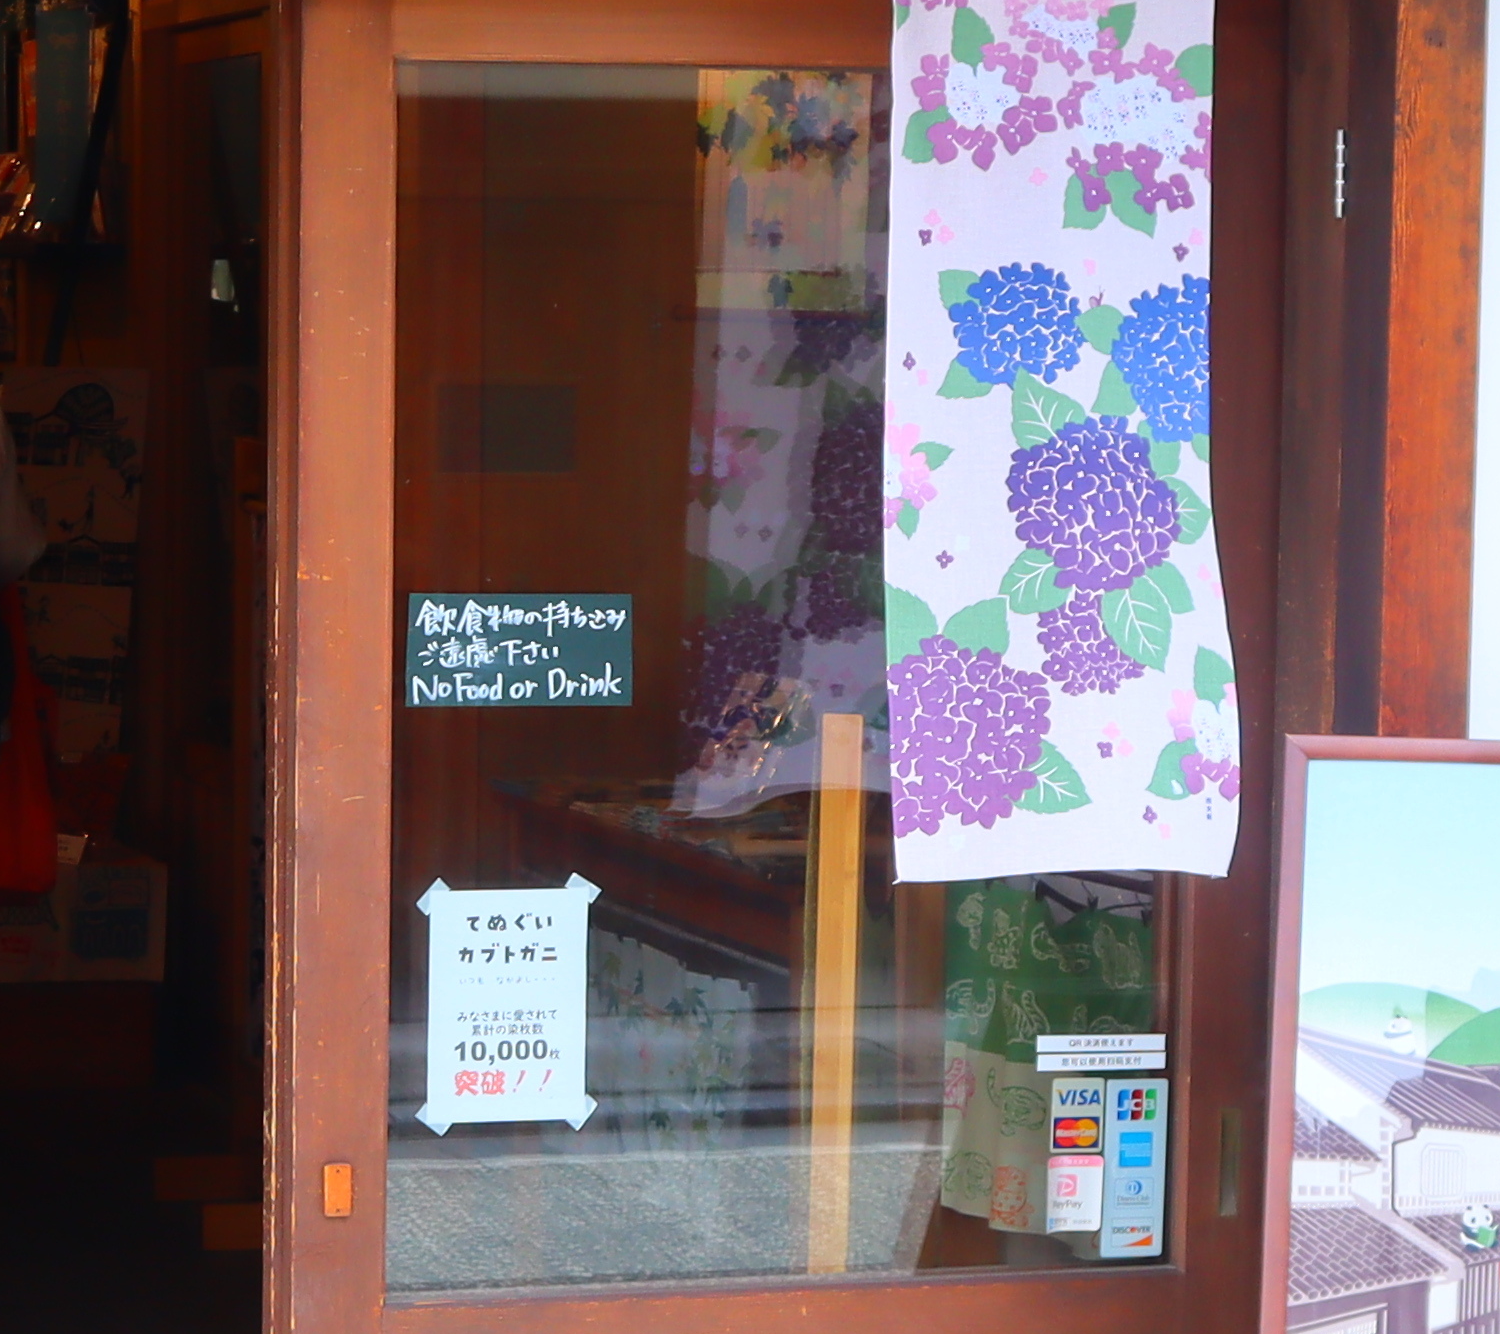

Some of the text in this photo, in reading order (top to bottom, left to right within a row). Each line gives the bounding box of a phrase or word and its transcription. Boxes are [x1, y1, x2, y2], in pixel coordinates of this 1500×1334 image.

[509, 679, 539, 700] or
[547, 662, 623, 700] Drink
[466, 913, 553, 932] てぬぐい
[458, 943, 558, 964] カブトガニ
[457, 1009, 558, 1022] みなさまに愛されて
[471, 1023, 544, 1036] 累計の染枚数
[1056, 1088, 1101, 1106] VISA
